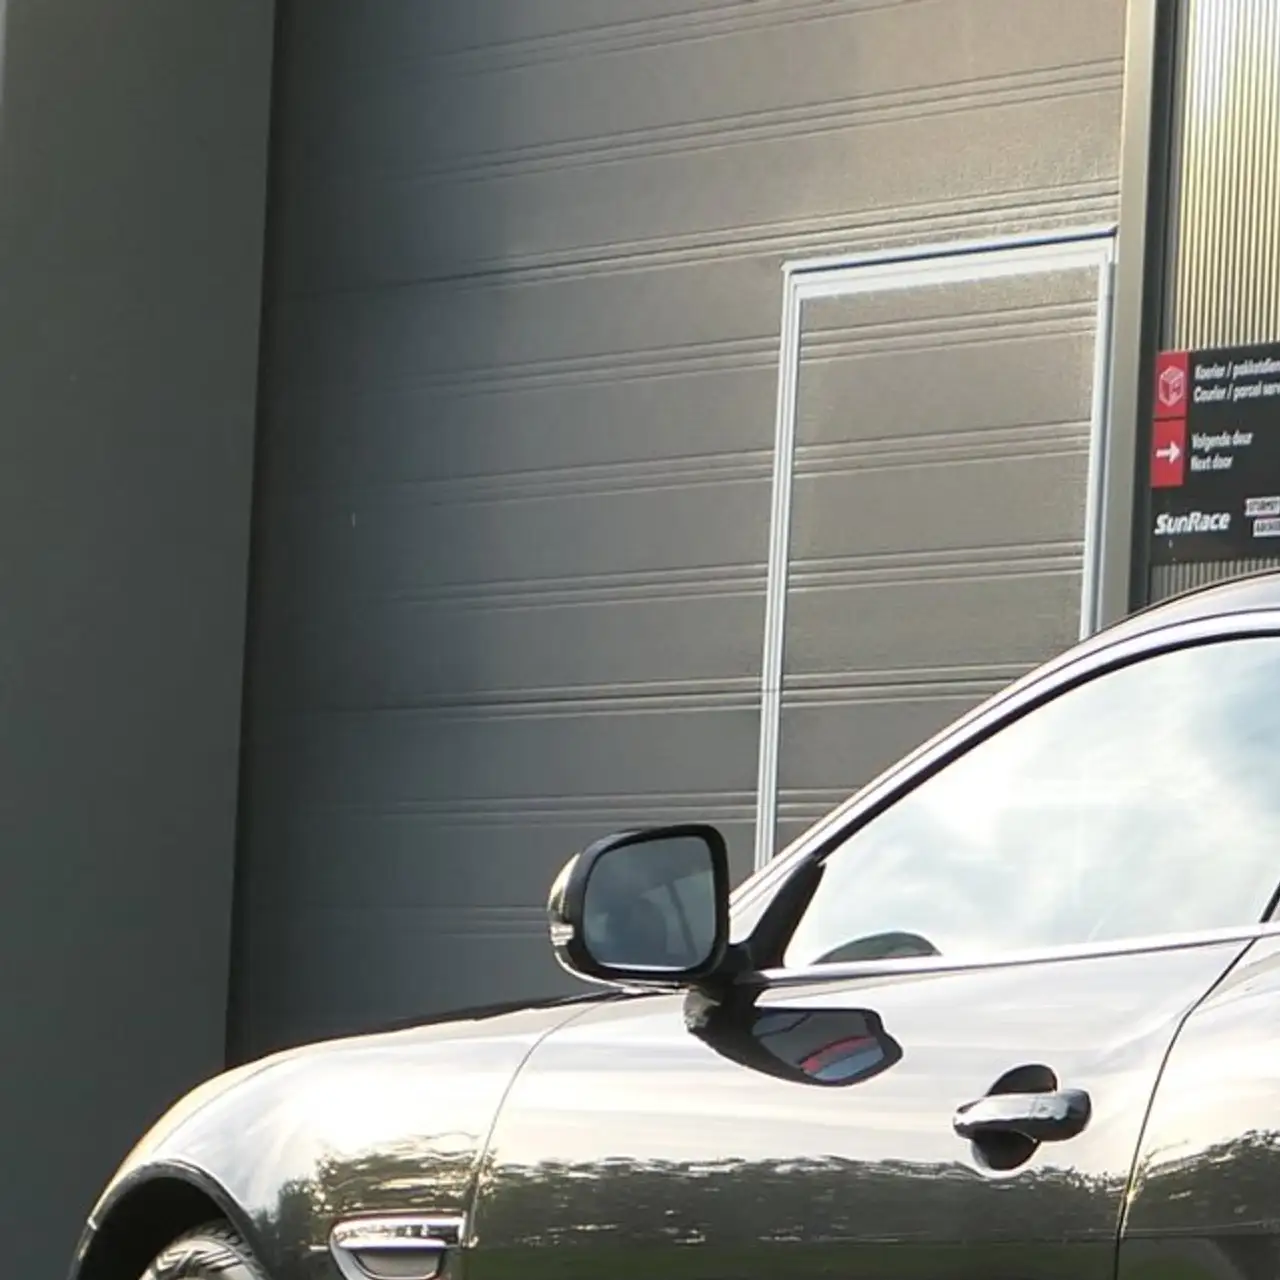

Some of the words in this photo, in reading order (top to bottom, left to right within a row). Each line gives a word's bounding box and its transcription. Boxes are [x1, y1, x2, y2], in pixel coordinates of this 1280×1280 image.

[1195, 363, 1225, 380] Koerier
[1194, 385, 1226, 403] Courier
[1233, 380, 1262, 402] parcel
[1192, 432, 1231, 452] Volgende
[1233, 429, 1253, 446] deur
[1191, 455, 1211, 472] Next
[1213, 453, 1233, 470] door
[1154, 511, 1231, 535] SunRace
